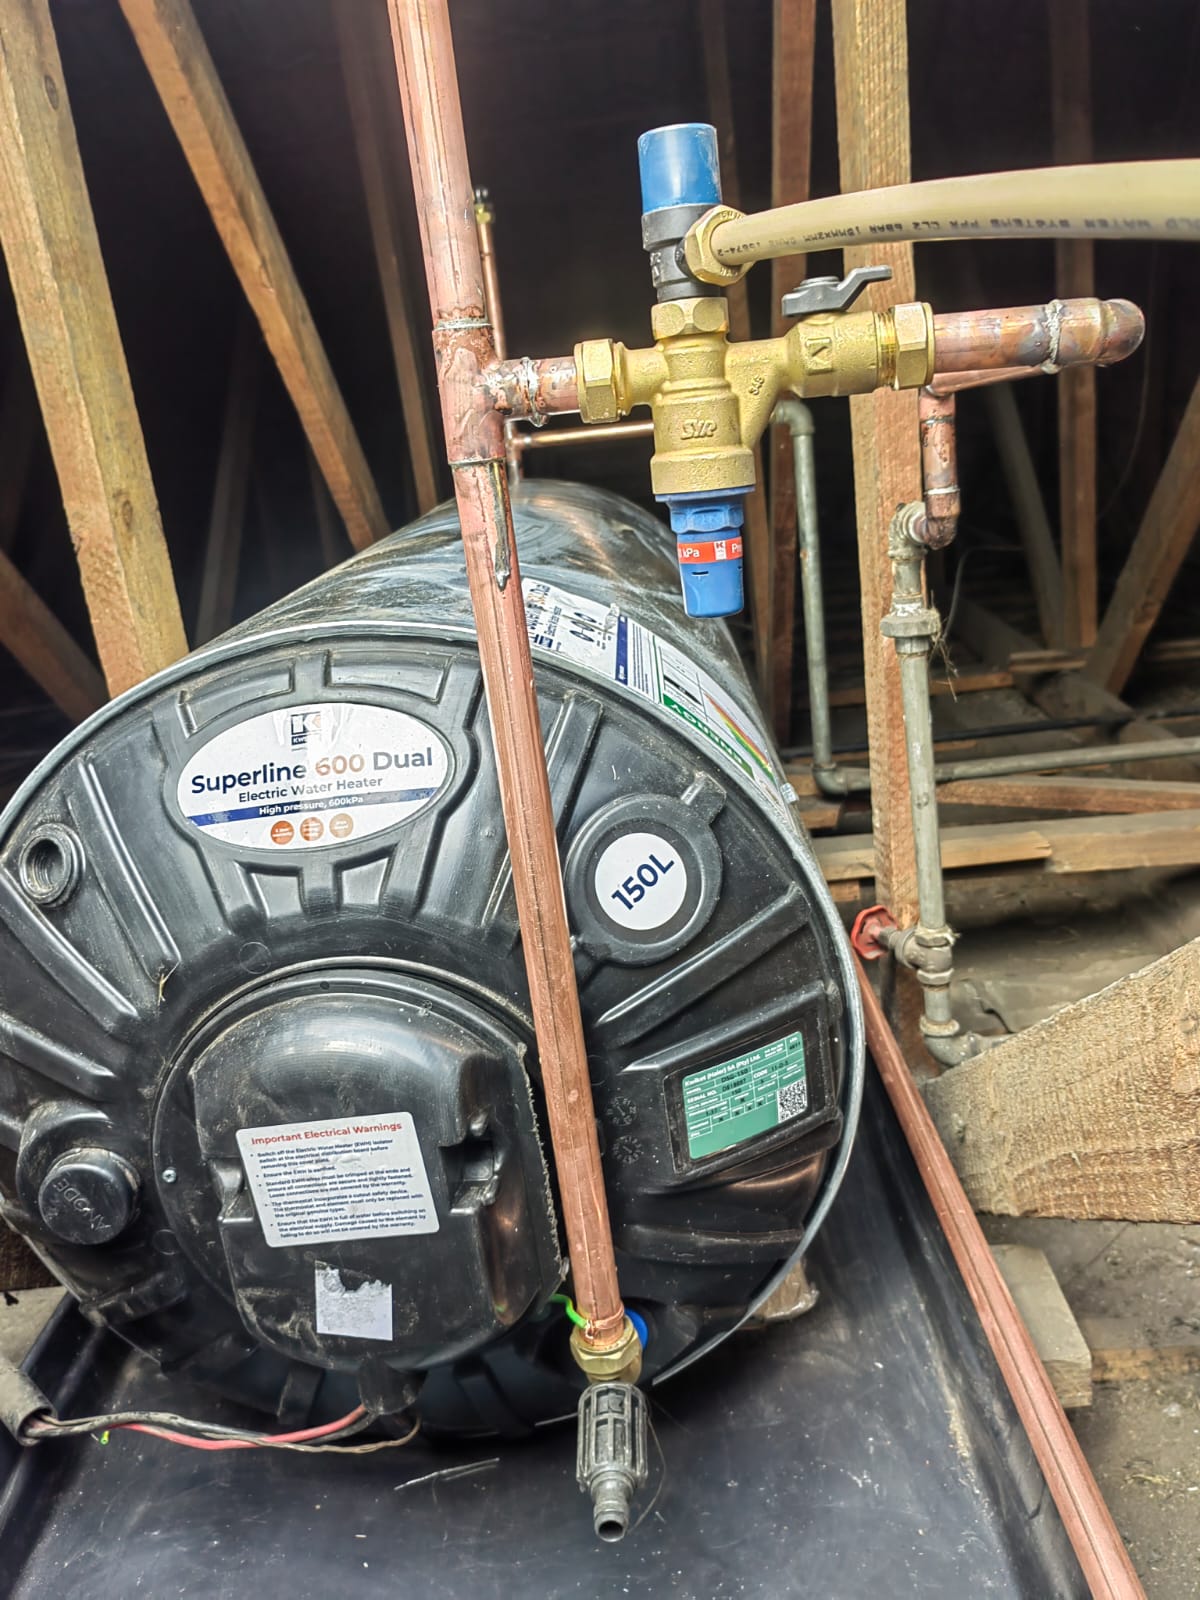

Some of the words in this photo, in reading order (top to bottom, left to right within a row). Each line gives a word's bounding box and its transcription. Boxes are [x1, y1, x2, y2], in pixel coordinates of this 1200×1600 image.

[192, 762, 307, 794] Superline
[315, 754, 365, 776] 600
[373, 746, 432, 771] Dual
[239, 786, 288, 802] Electric
[291, 782, 333, 796] Water
[336, 778, 384, 790] Heater
[259, 806, 281, 816] High
[284, 800, 328, 813] pressure,
[328, 796, 364, 806] 600kPa
[611, 854, 675, 910] 150L
[252, 1133, 302, 1146] Important
[305, 1128, 350, 1140] Electrical
[354, 1123, 402, 1135] Warnings
